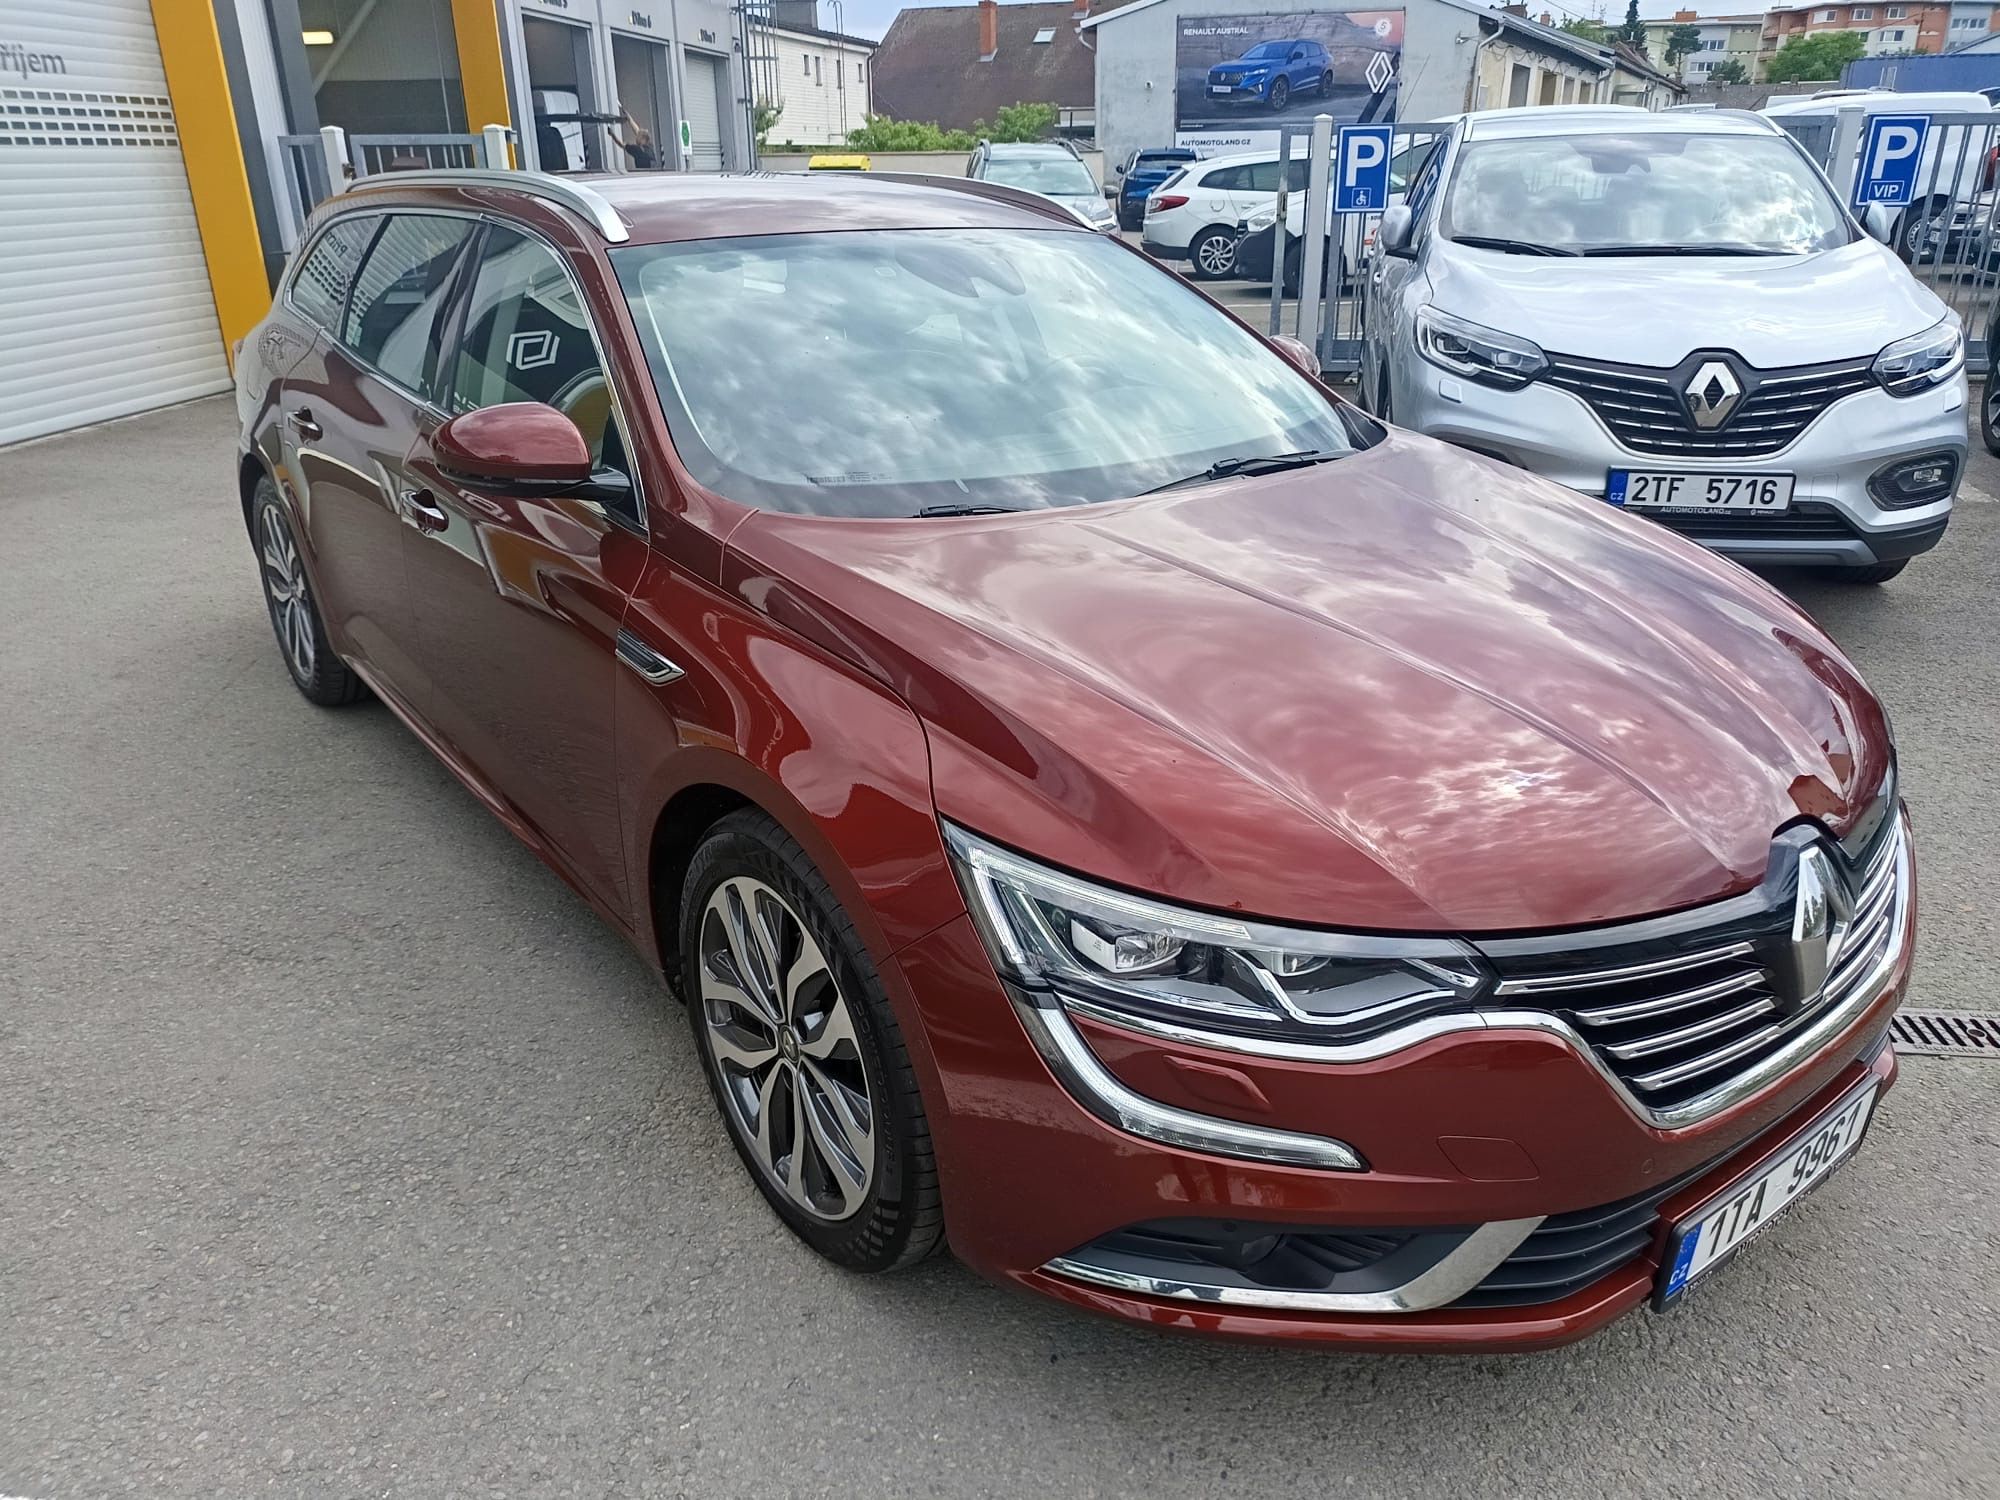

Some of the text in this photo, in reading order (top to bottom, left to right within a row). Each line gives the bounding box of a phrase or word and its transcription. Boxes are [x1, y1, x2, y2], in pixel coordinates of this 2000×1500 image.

[1183, 27, 1249, 36] RENAULT AUSTRAL
[1345, 136, 1385, 187] P
[1870, 126, 1918, 179] P
[1873, 184, 1899, 198] VIP
[1610, 492, 1624, 501] CZ
[1632, 476, 1778, 506] 2TF 5716
[1709, 1100, 1863, 1258] 1TA 9961
[1669, 1263, 1687, 1286] CZ
